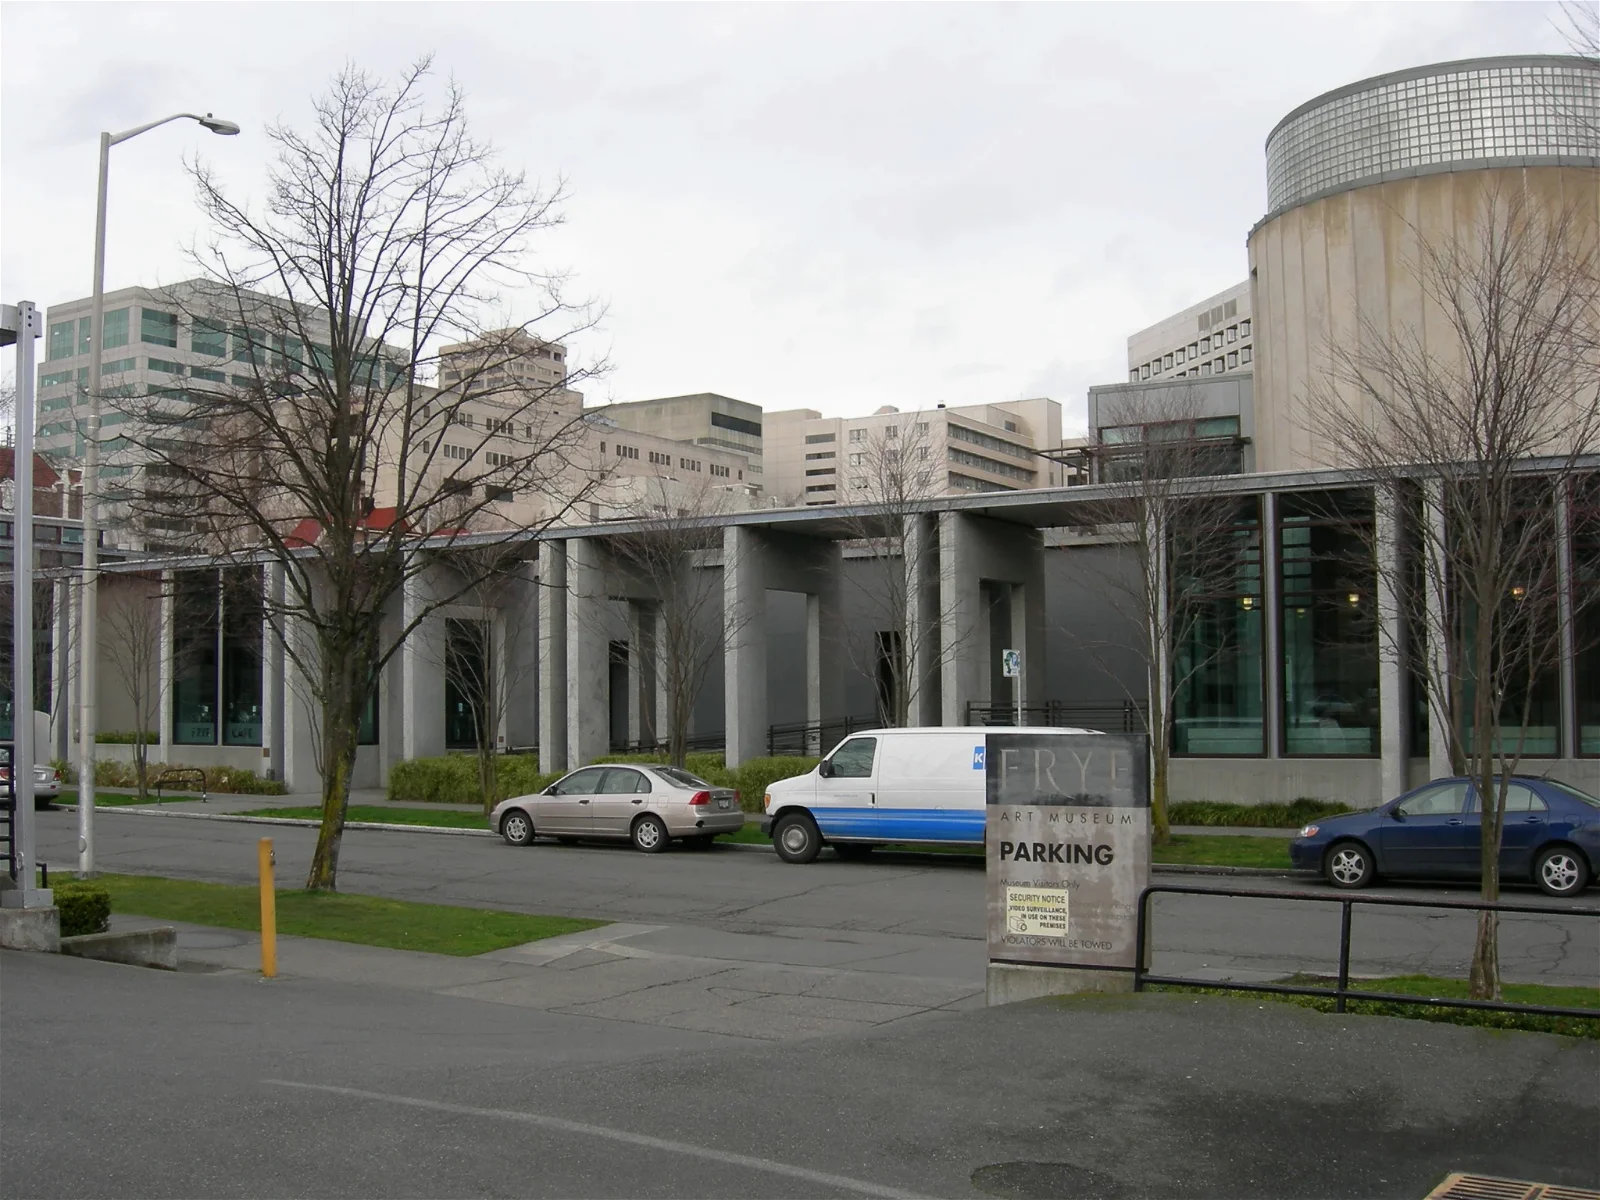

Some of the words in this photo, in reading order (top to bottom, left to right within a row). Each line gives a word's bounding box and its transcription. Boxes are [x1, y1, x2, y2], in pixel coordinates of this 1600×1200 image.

[1000, 748, 1131, 800] FRYE
[1001, 812, 1034, 822] ART
[1050, 813, 1132, 825] MUSEUM
[1001, 841, 1114, 865] PARKING
[1000, 879, 1031, 887] Museum
[1033, 880, 1059, 888] Visitors
[1061, 880, 1081, 890] Only
[1010, 893, 1041, 902] SECURITY
[1042, 895, 1065, 904] NOTICE
[1001, 936, 1046, 946] VIOLATORS
[1048, 939, 1066, 948] WILL
[1069, 940, 1079, 948] BE
[1080, 940, 1112, 950] TOWED
